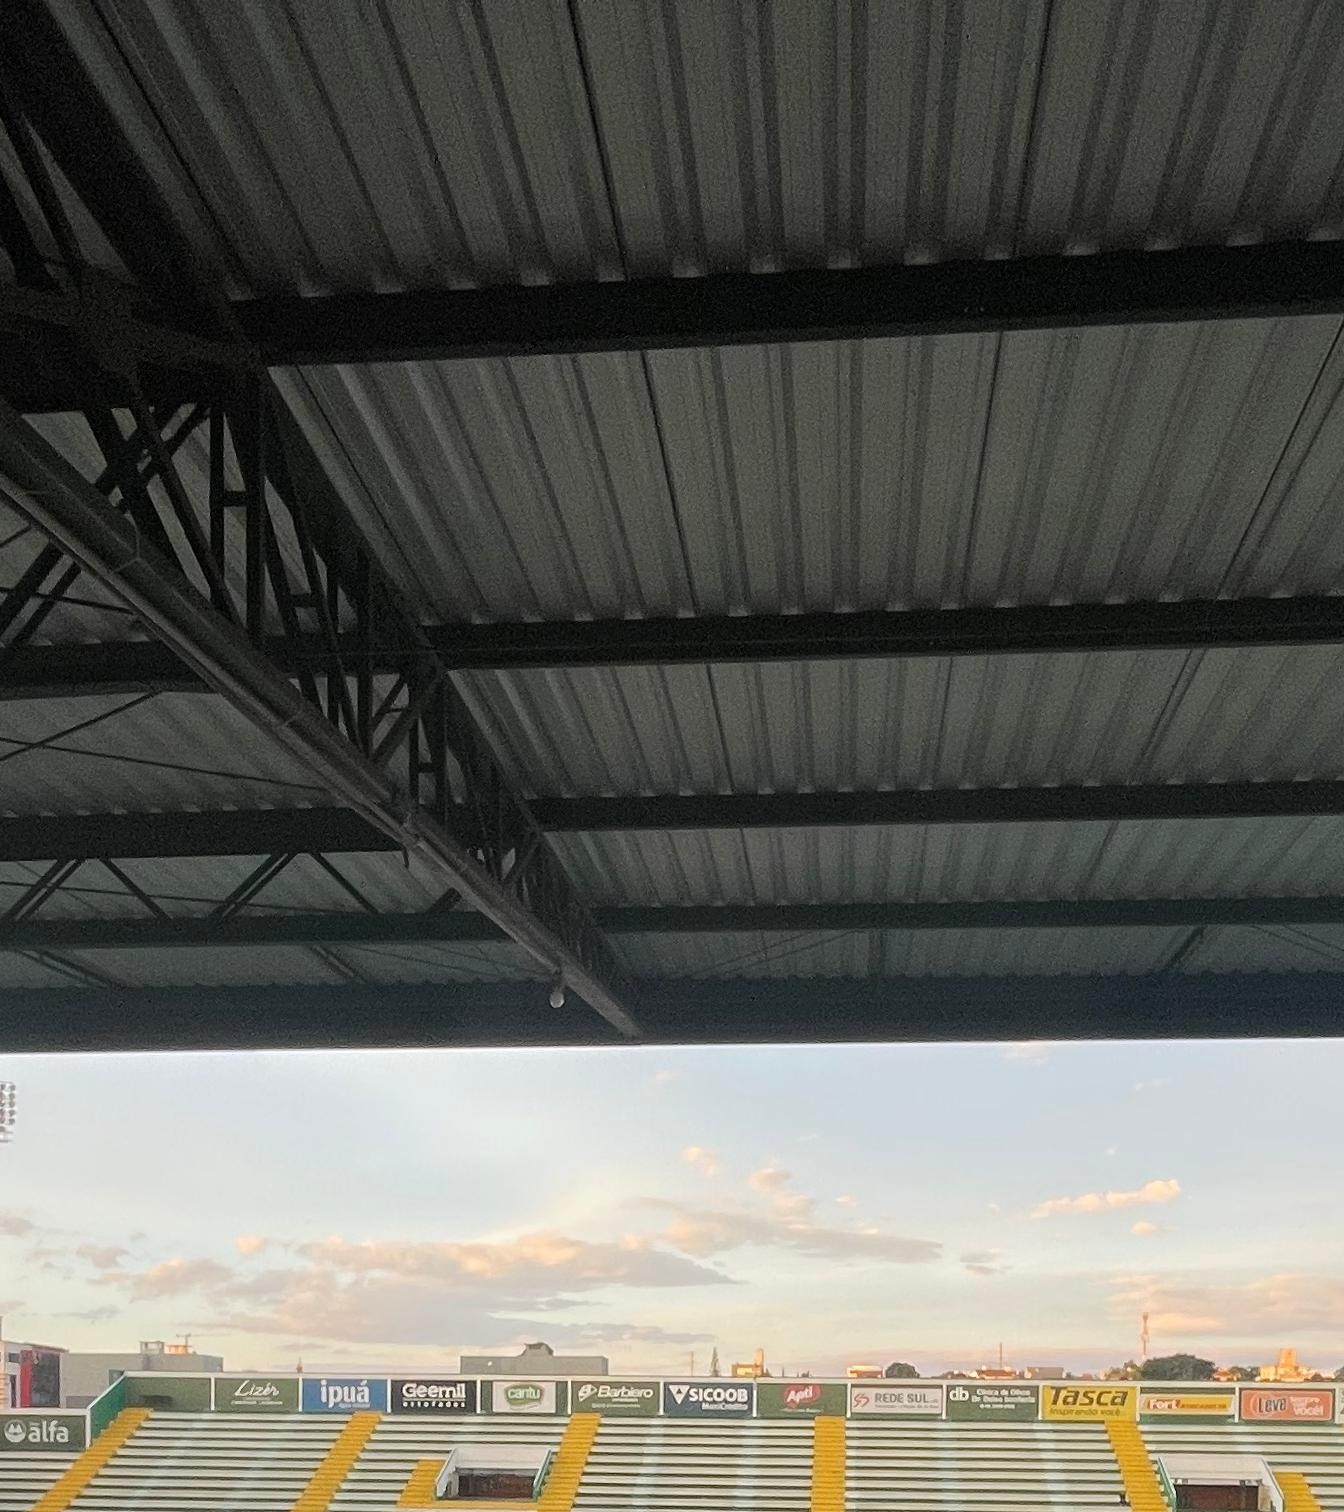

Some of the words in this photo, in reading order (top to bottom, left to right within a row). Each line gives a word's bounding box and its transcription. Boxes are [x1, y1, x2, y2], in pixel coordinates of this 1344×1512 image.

[321, 1380, 370, 1408] ipuá
[402, 1383, 466, 1398] Geemil
[508, 1388, 540, 1400] cantu
[689, 1388, 748, 1403] SICOOB
[949, 1386, 969, 1401] db
[875, 1393, 904, 1404] REDE
[907, 1393, 928, 1404] SUL
[1149, 1399, 1177, 1409] Fort
